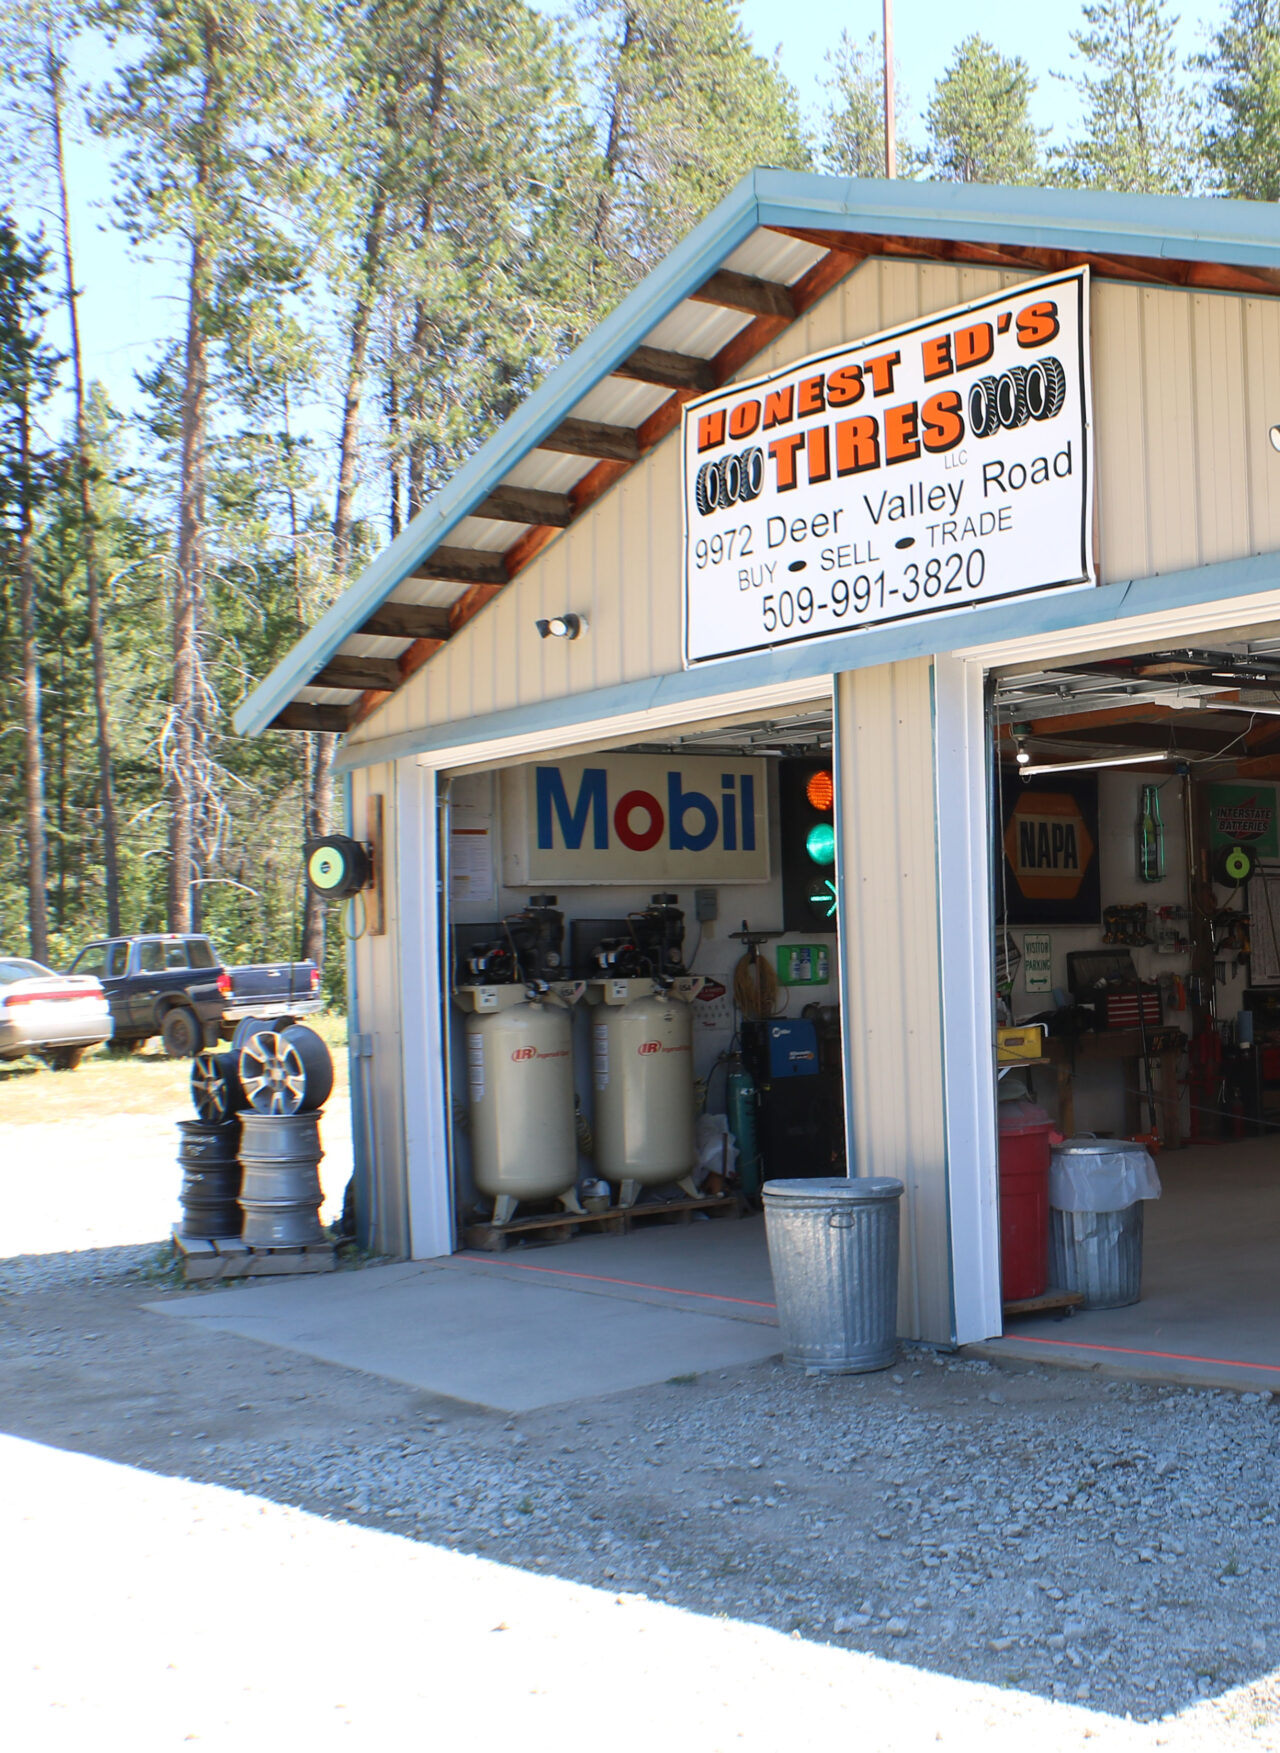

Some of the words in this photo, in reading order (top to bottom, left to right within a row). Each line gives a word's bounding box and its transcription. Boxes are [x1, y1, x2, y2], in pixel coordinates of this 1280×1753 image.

[697, 350, 900, 454] HONEST
[921, 300, 1060, 382] ED'S
[768, 390, 964, 493] TIRES
[943, 449, 968, 470] LLC
[694, 524, 754, 569] 9972
[766, 508, 844, 549] Deer
[863, 479, 965, 527] Valley
[982, 440, 1073, 497] Road
[738, 561, 778, 592] BUY
[820, 540, 880, 572] SELL
[925, 505, 1014, 548] TRADE
[761, 548, 986, 632] 509-991-3820
[535, 766, 756, 853] Mobil
[1215, 807, 1272, 819] INTERSTATE
[1218, 821, 1269, 832] BATTERIES
[1019, 821, 1080, 870] NAPA
[1025, 942, 1049, 954] VISITOR
[1025, 959, 1051, 971] PARKING
[514, 1047, 534, 1060] IR
[640, 1041, 660, 1055] IR
